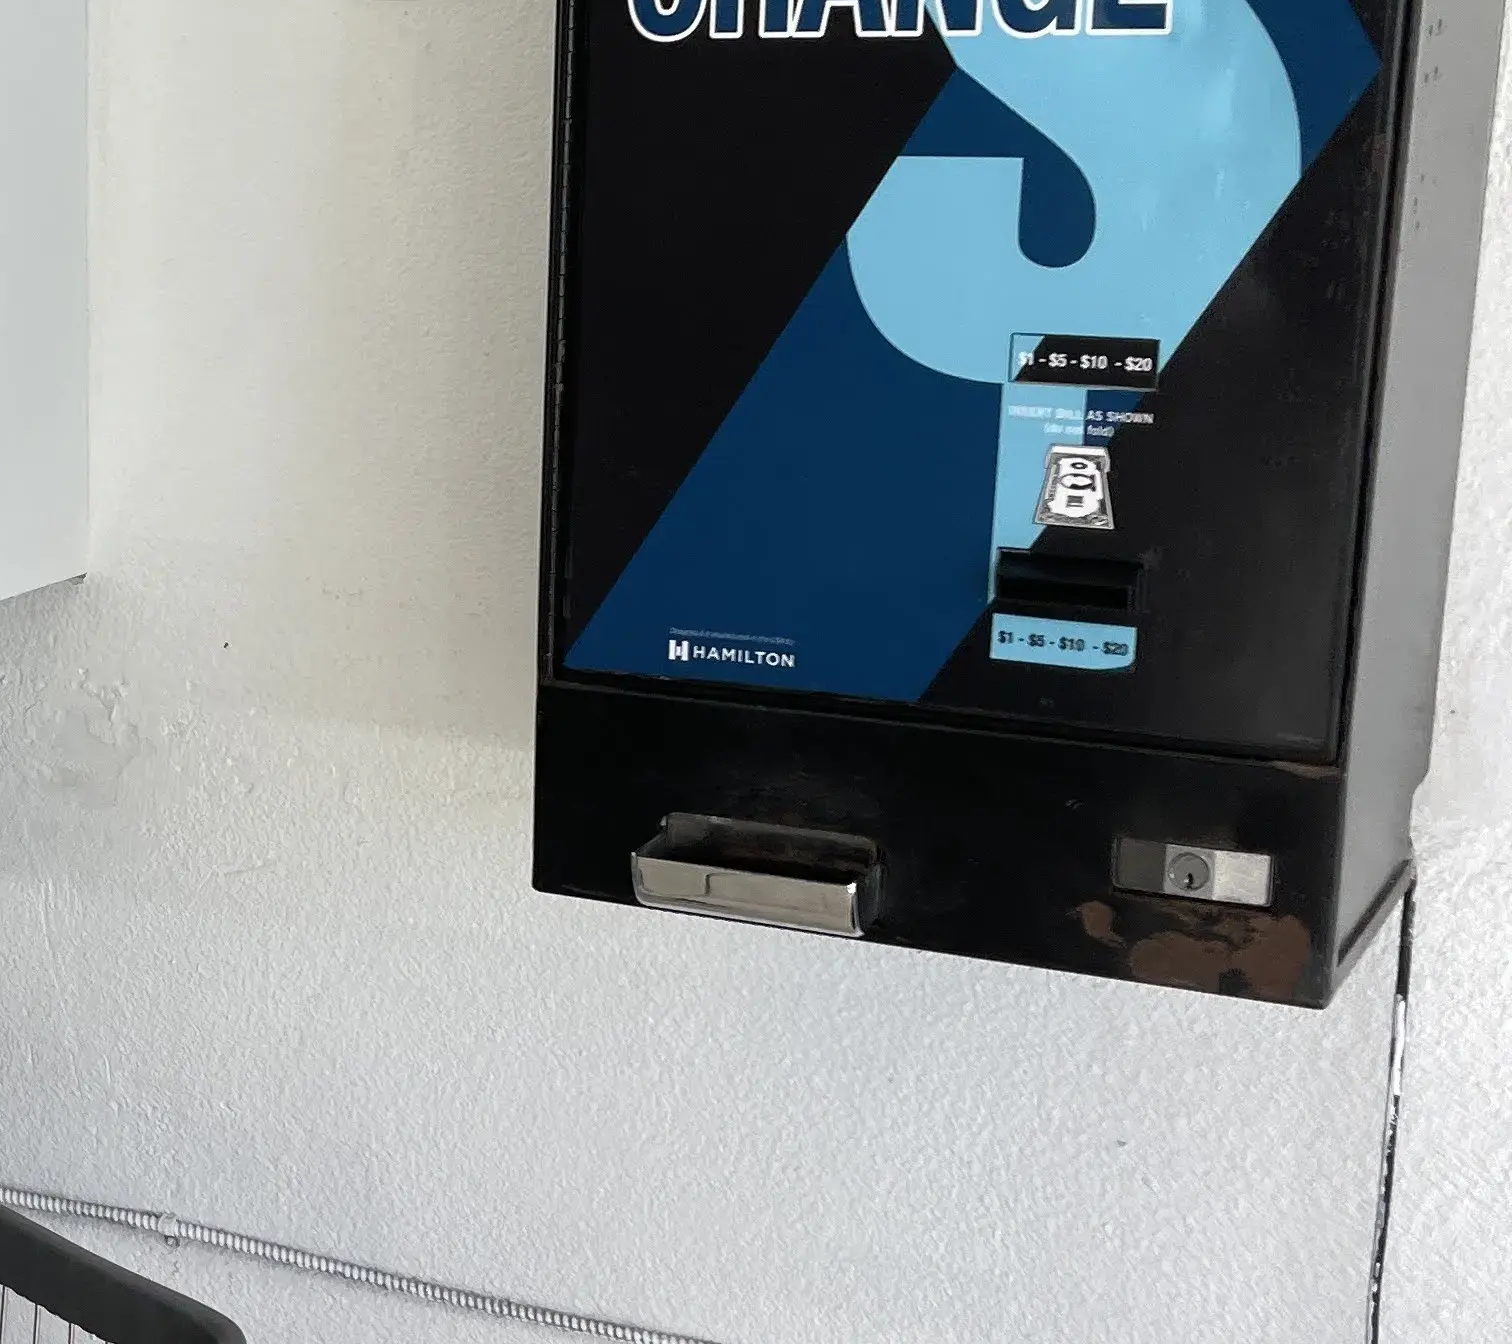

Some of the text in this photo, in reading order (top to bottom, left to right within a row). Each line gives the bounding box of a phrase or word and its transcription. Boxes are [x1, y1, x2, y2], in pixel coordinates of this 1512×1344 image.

[1018, 351, 1034, 366] $1
[1048, 352, 1068, 368] $5
[1080, 354, 1108, 369] $10
[1124, 356, 1153, 372] $20
[1085, 410, 1104, 421] AS
[1106, 411, 1154, 424] SHOWN
[998, 630, 1014, 644] $1
[1027, 633, 1046, 647] $5
[1058, 636, 1085, 651] $10
[1102, 641, 1129, 656] $20
[693, 645, 796, 668] HAMILTON
